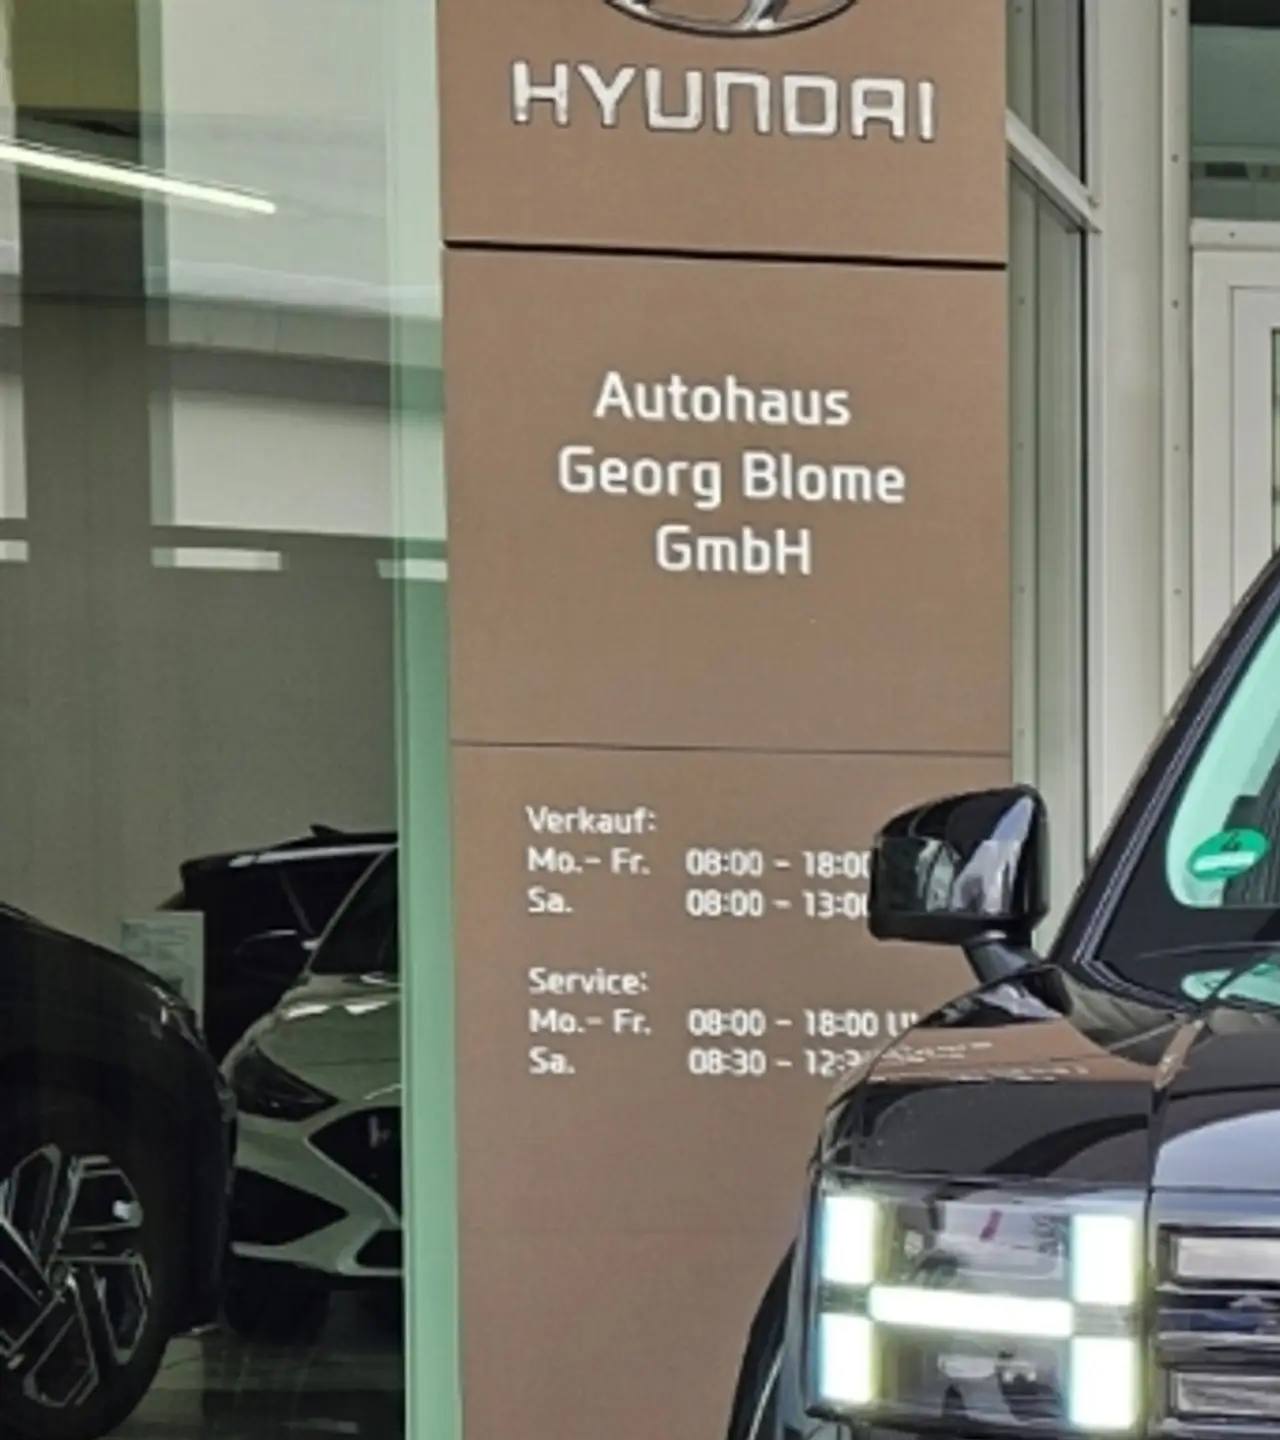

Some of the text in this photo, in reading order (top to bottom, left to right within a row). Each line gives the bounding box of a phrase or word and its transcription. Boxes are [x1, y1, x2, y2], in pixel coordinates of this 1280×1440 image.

[511, 60, 936, 141] HYUNDAI
[593, 371, 852, 426] Autohaus
[558, 445, 906, 510] Georg Blome
[655, 524, 812, 575] GmbH
[525, 805, 657, 834] Verkauf:
[610, 847, 651, 875] Fr.
[685, 848, 764, 877] 08:00
[527, 886, 573, 913] Sa.
[685, 888, 764, 917] 08:00
[528, 966, 649, 995] Service:
[612, 1008, 652, 1035] Fr.
[687, 1008, 766, 1037] 08:00
[804, 1009, 879, 1037] 18:00
[528, 1046, 575, 1074] Sa.
[688, 1048, 767, 1075] 08:30
